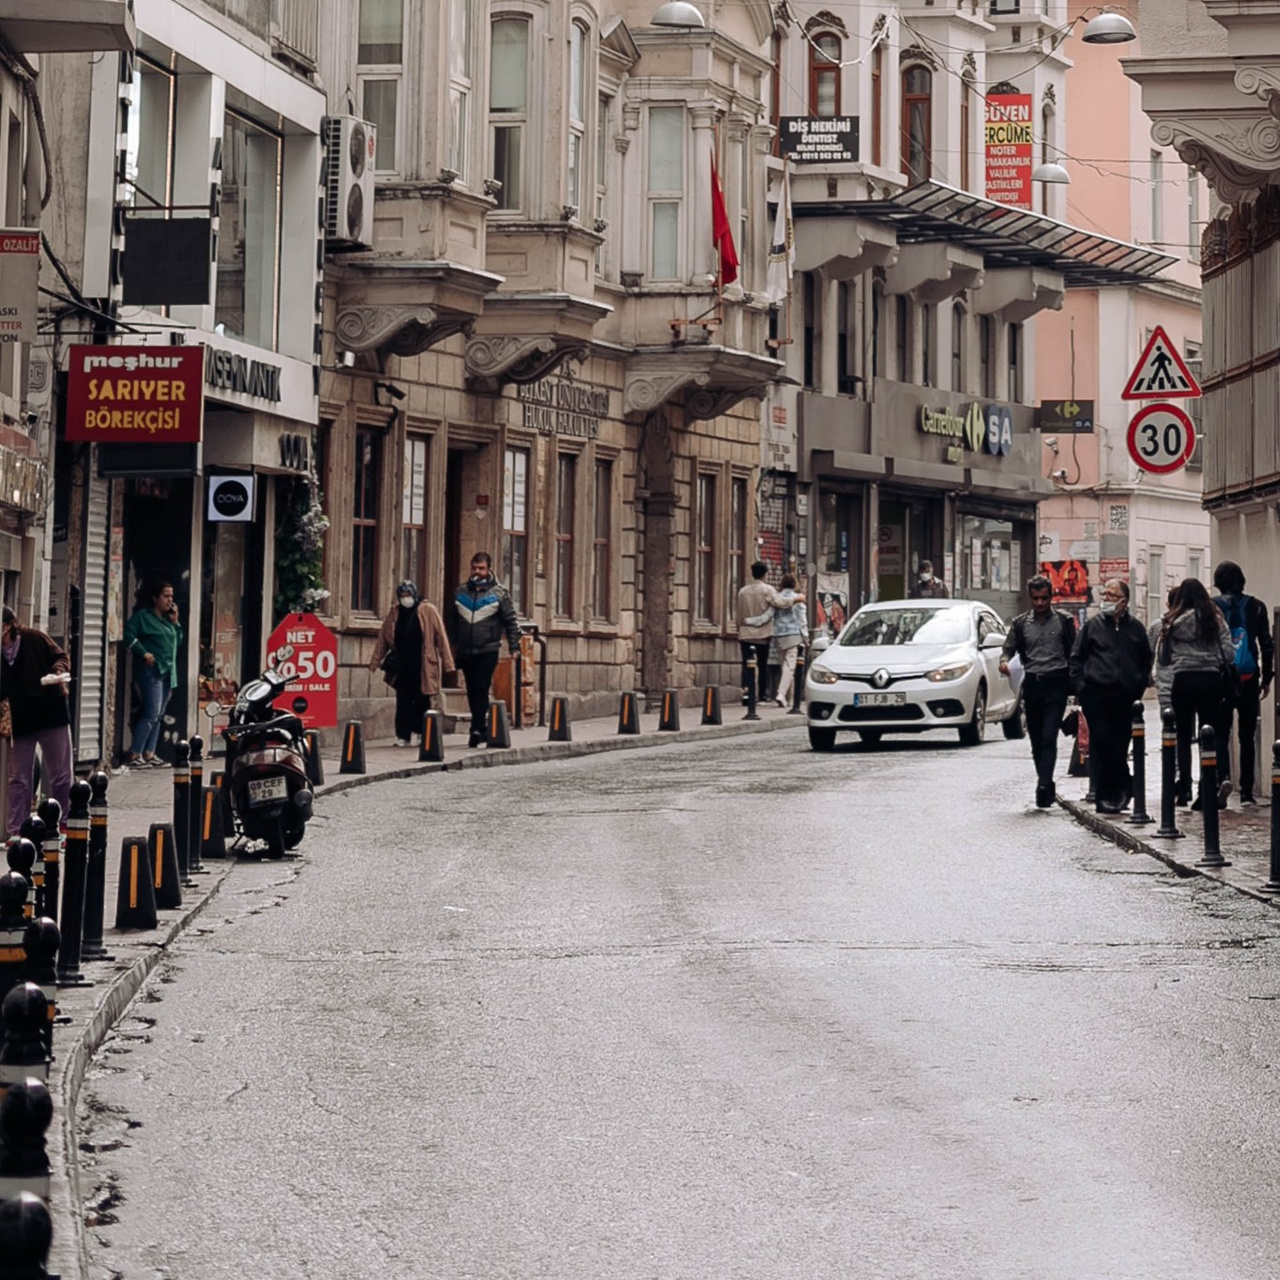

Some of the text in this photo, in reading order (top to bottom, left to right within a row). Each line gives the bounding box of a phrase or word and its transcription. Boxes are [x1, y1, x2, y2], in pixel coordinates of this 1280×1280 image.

[83, 353, 184, 373] meşhur
[88, 378, 186, 401] SARIYER
[85, 406, 180, 433] BÖREKÇİSİ
[921, 403, 1012, 445] Carrefour SA
[1075, 420, 1092, 428] SA
[1141, 423, 1182, 457] 30
[286, 630, 316, 643] NET
[309, 683, 331, 692] SALE
